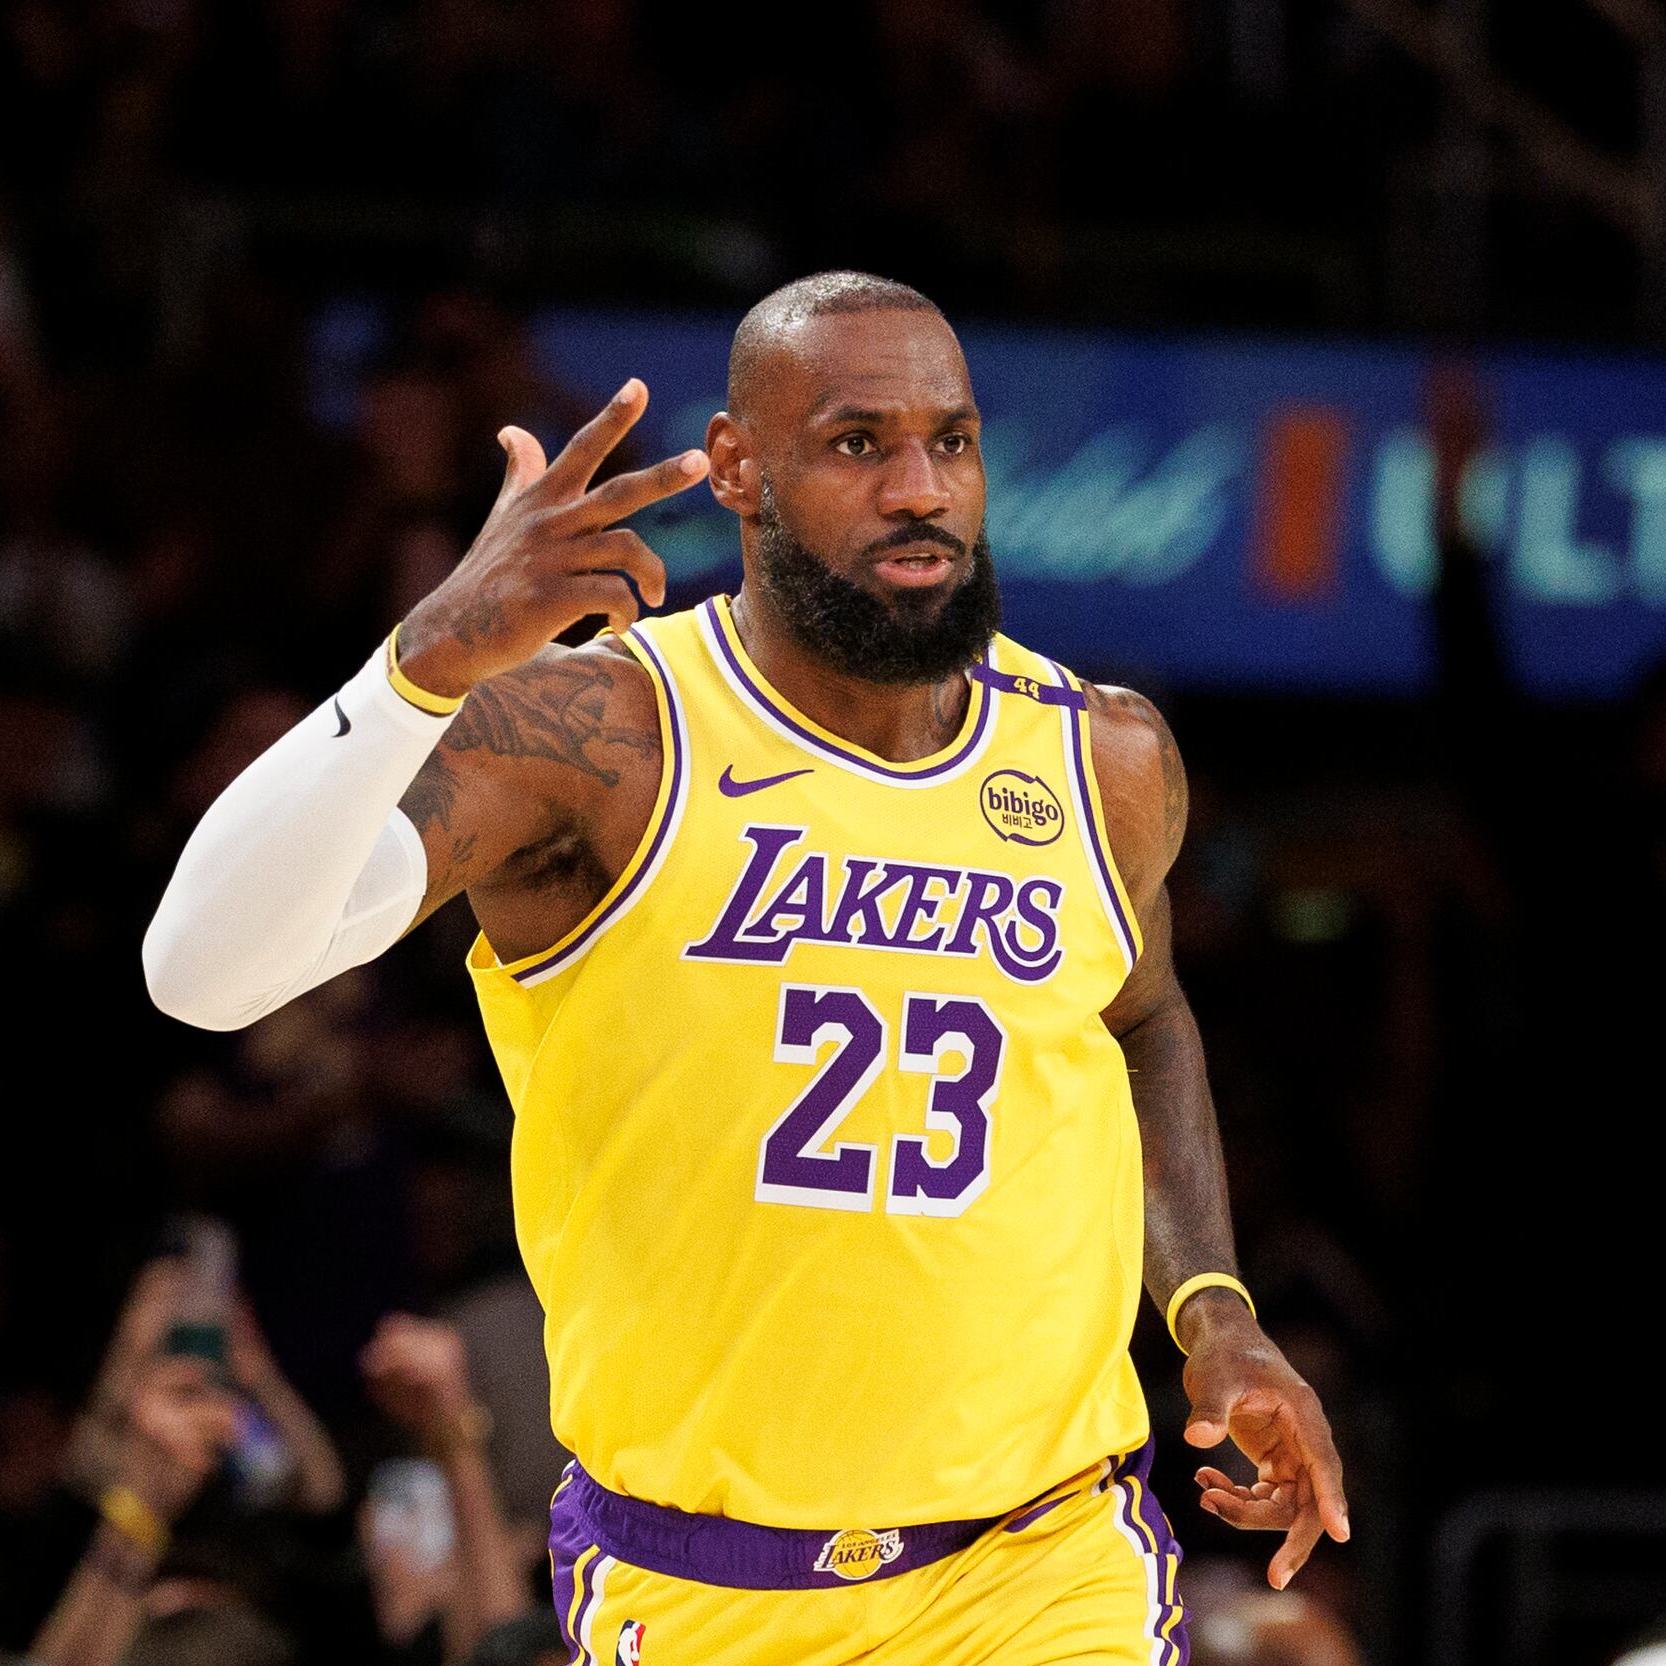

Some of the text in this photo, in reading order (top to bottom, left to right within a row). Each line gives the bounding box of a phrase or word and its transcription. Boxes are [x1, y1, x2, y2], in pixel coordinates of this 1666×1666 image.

[1014, 677, 1040, 699] 44
[988, 787, 1058, 826] bibigo
[1002, 814, 1032, 828] 비비고
[681, 824, 1064, 984] LAKERS
[754, 983, 1008, 1218] 23
[814, 1541, 904, 1571] LAKERS
